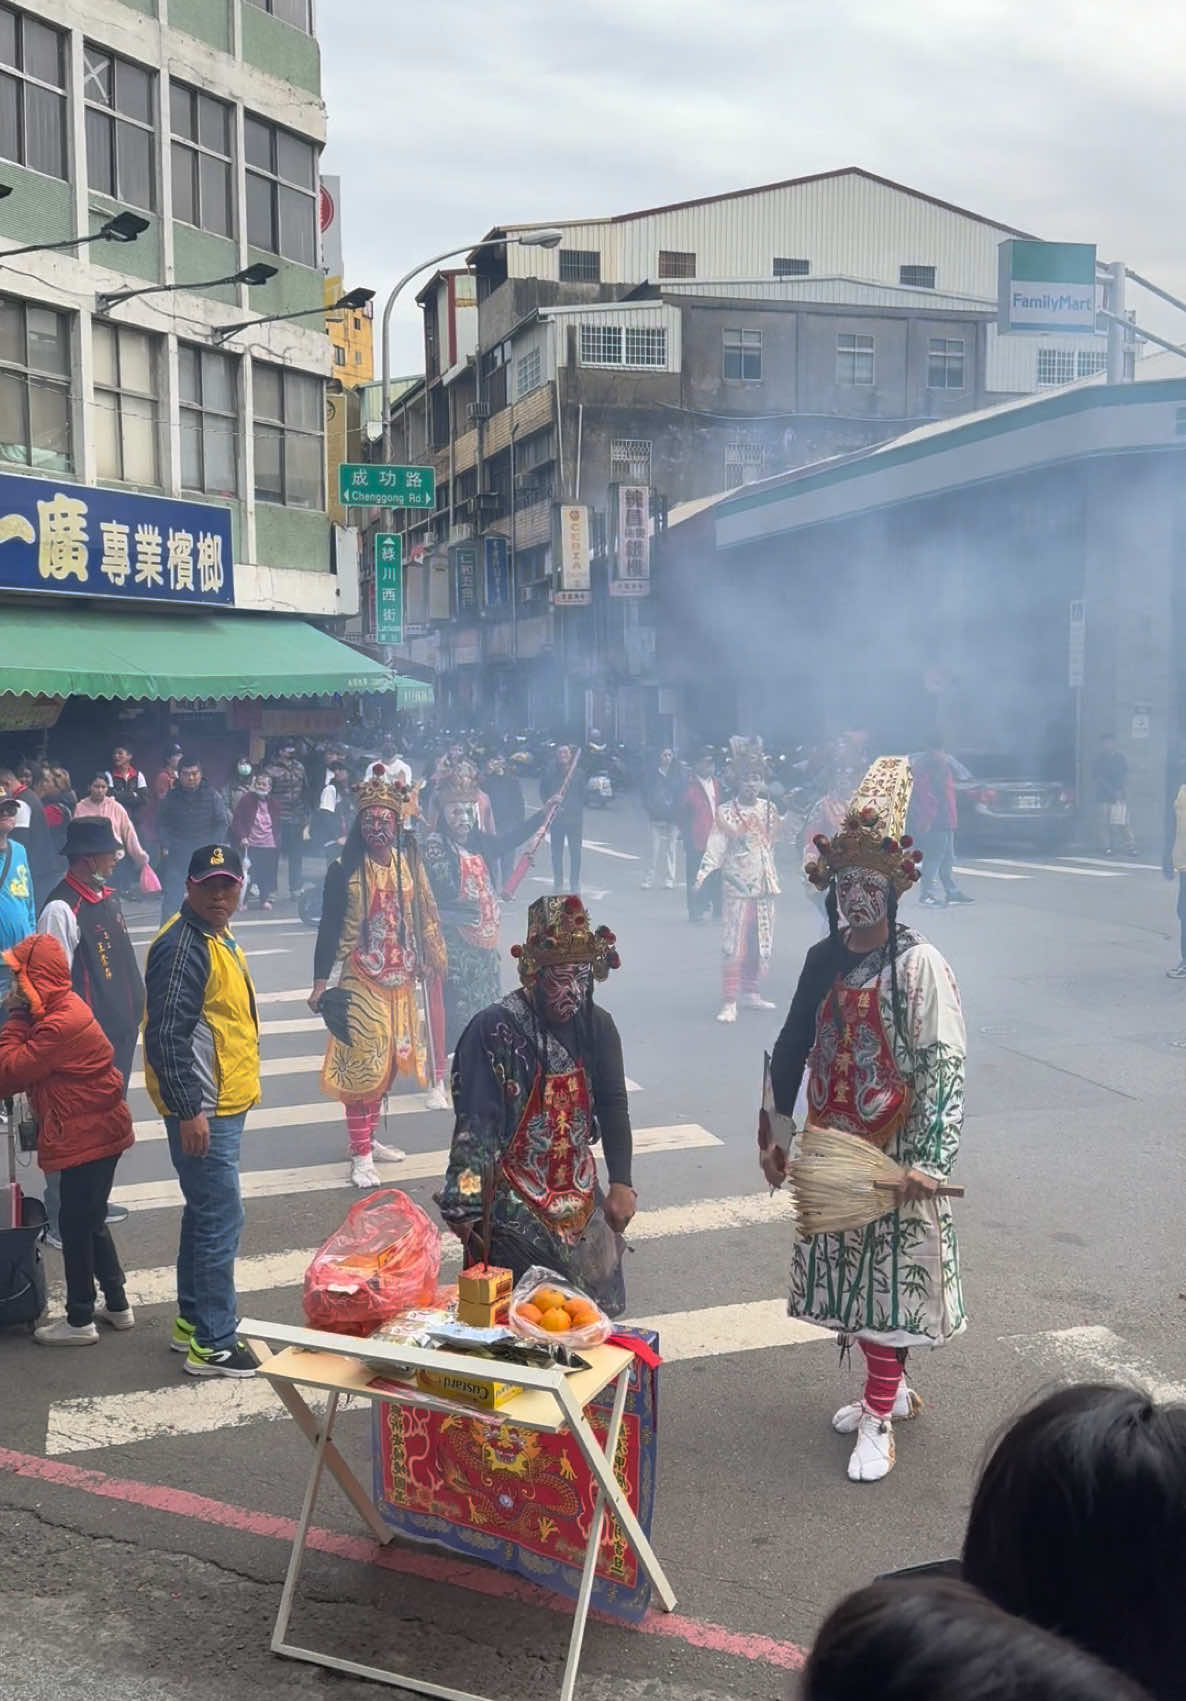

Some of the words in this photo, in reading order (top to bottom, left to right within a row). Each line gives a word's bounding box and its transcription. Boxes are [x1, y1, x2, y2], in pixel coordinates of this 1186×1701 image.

[1013, 293, 1092, 312] FamilyMart
[352, 468, 423, 488] 成功路
[352, 490, 405, 504] Chenggong
[443, 1377, 489, 1401] Custard
